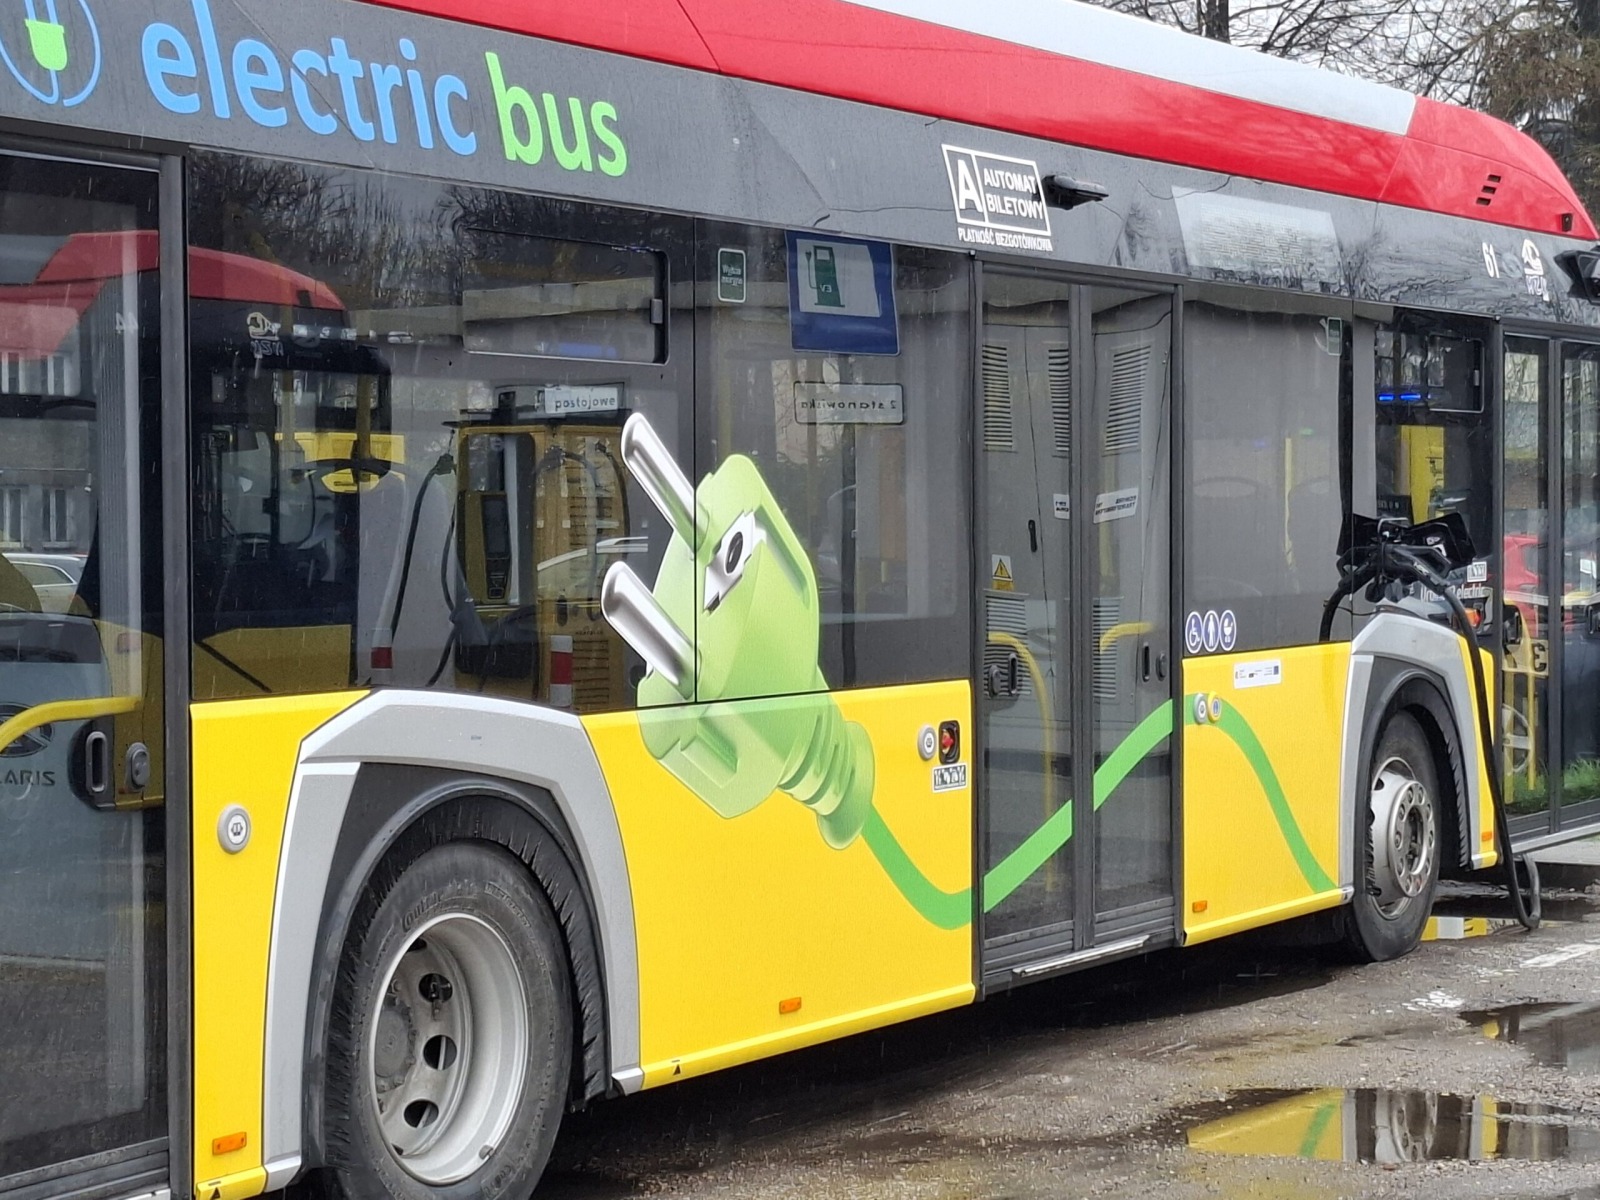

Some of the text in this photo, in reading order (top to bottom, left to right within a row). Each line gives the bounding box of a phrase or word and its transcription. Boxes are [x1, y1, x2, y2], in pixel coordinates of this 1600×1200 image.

[141, 0, 628, 178] electric bus
[958, 159, 984, 213] A
[984, 168, 1037, 194] AUTOMAT
[986, 193, 1043, 220] BILETOWY
[555, 394, 616, 412] postojowe
[0, 769, 56, 787] ARIS
